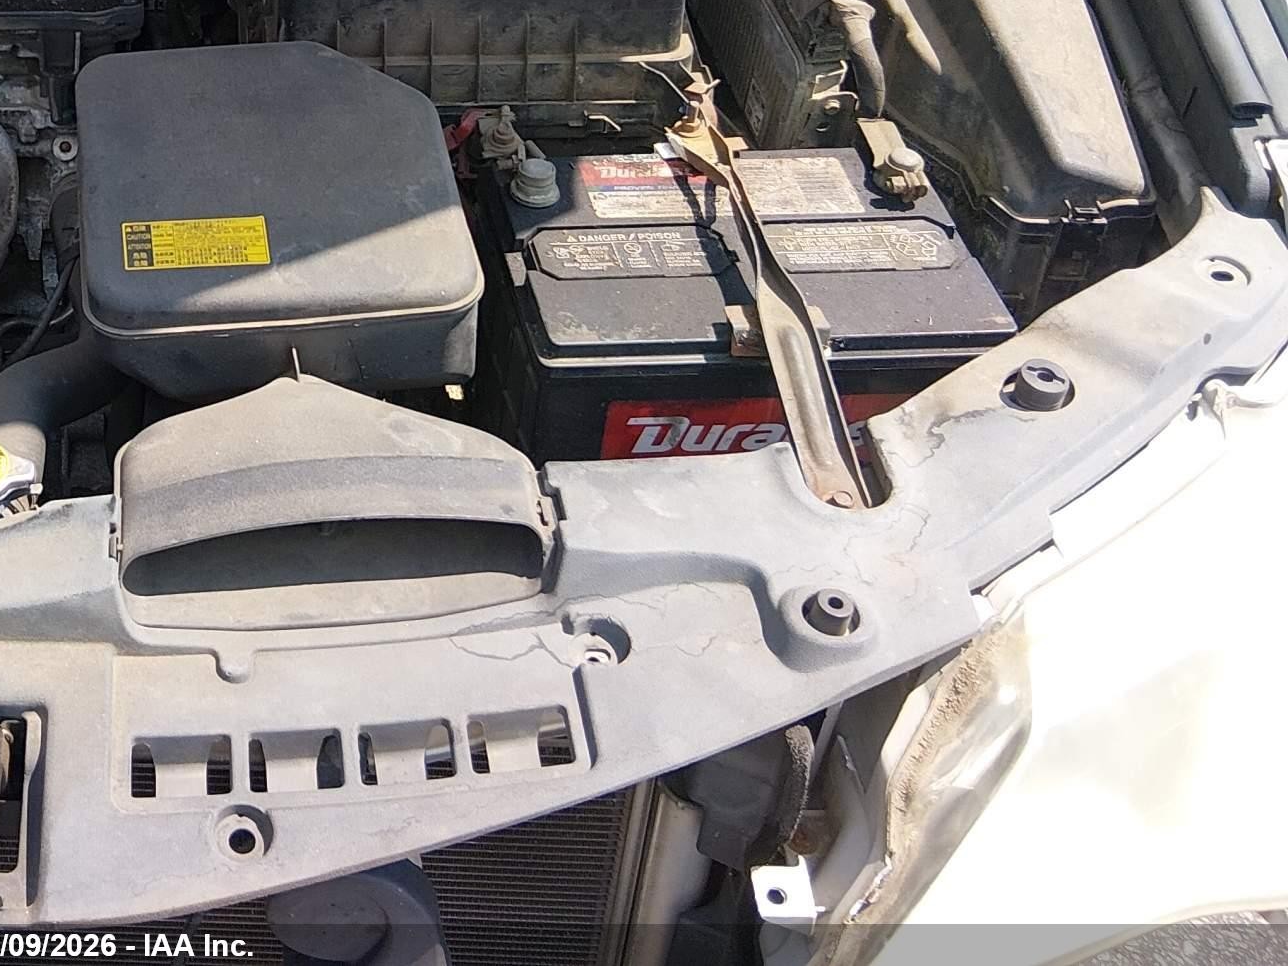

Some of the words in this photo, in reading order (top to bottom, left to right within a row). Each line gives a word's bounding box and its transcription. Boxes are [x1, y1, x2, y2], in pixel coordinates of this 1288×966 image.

[126, 233, 151, 241] CAUTION
[578, 233, 626, 242] DANGER
[637, 232, 681, 240] POISON
